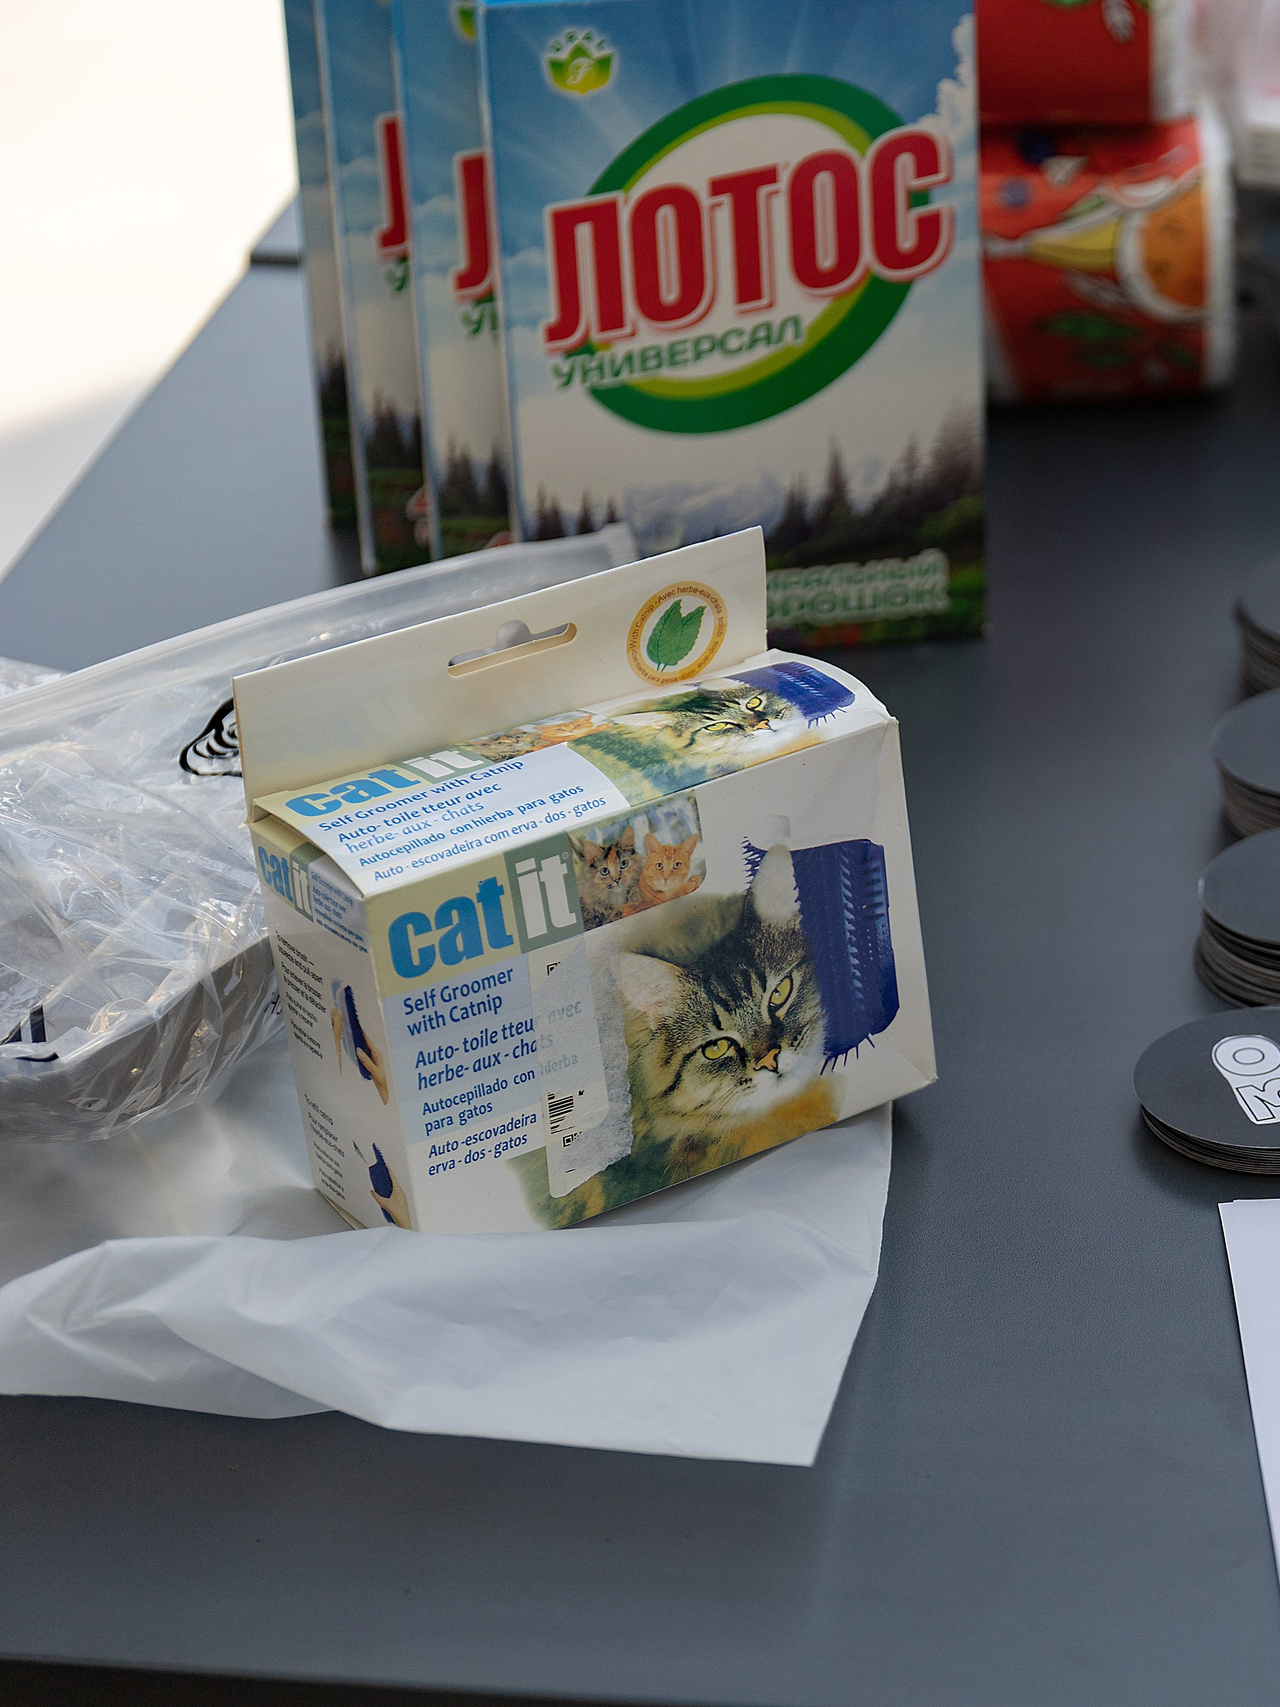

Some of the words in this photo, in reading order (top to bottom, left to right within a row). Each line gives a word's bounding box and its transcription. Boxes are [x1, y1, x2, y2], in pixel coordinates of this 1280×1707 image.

[546, 129, 953, 353] ЛОТОС
[552, 315, 806, 390] УНИВЕРСАЛ
[658, 589, 676, 603] Avec
[629, 625, 639, 649] With
[635, 604, 655, 628] Catnip
[319, 814, 354, 831] Self
[354, 791, 428, 819] Groomer
[431, 775, 469, 794] with
[470, 760, 524, 781] Catnip
[338, 823, 381, 843] Auto-
[465, 783, 502, 801] avec
[358, 831, 446, 867] Autocepillado
[450, 821, 473, 835] con
[473, 809, 514, 827] hierba
[516, 799, 546, 815] para
[548, 784, 584, 805] gatos
[374, 865, 404, 881] Auto
[411, 838, 483, 869] escovadeira
[484, 829, 509, 844] com
[403, 989, 437, 1016] Self
[440, 968, 514, 1004] Groomer
[406, 1010, 446, 1036] with
[449, 994, 503, 1023] Catnip
[414, 1046, 459, 1069] Auto-
[422, 1077, 508, 1116] Autocepillado
[513, 1069, 535, 1085] con
[424, 1115, 454, 1136] para
[458, 1101, 493, 1126] gatos
